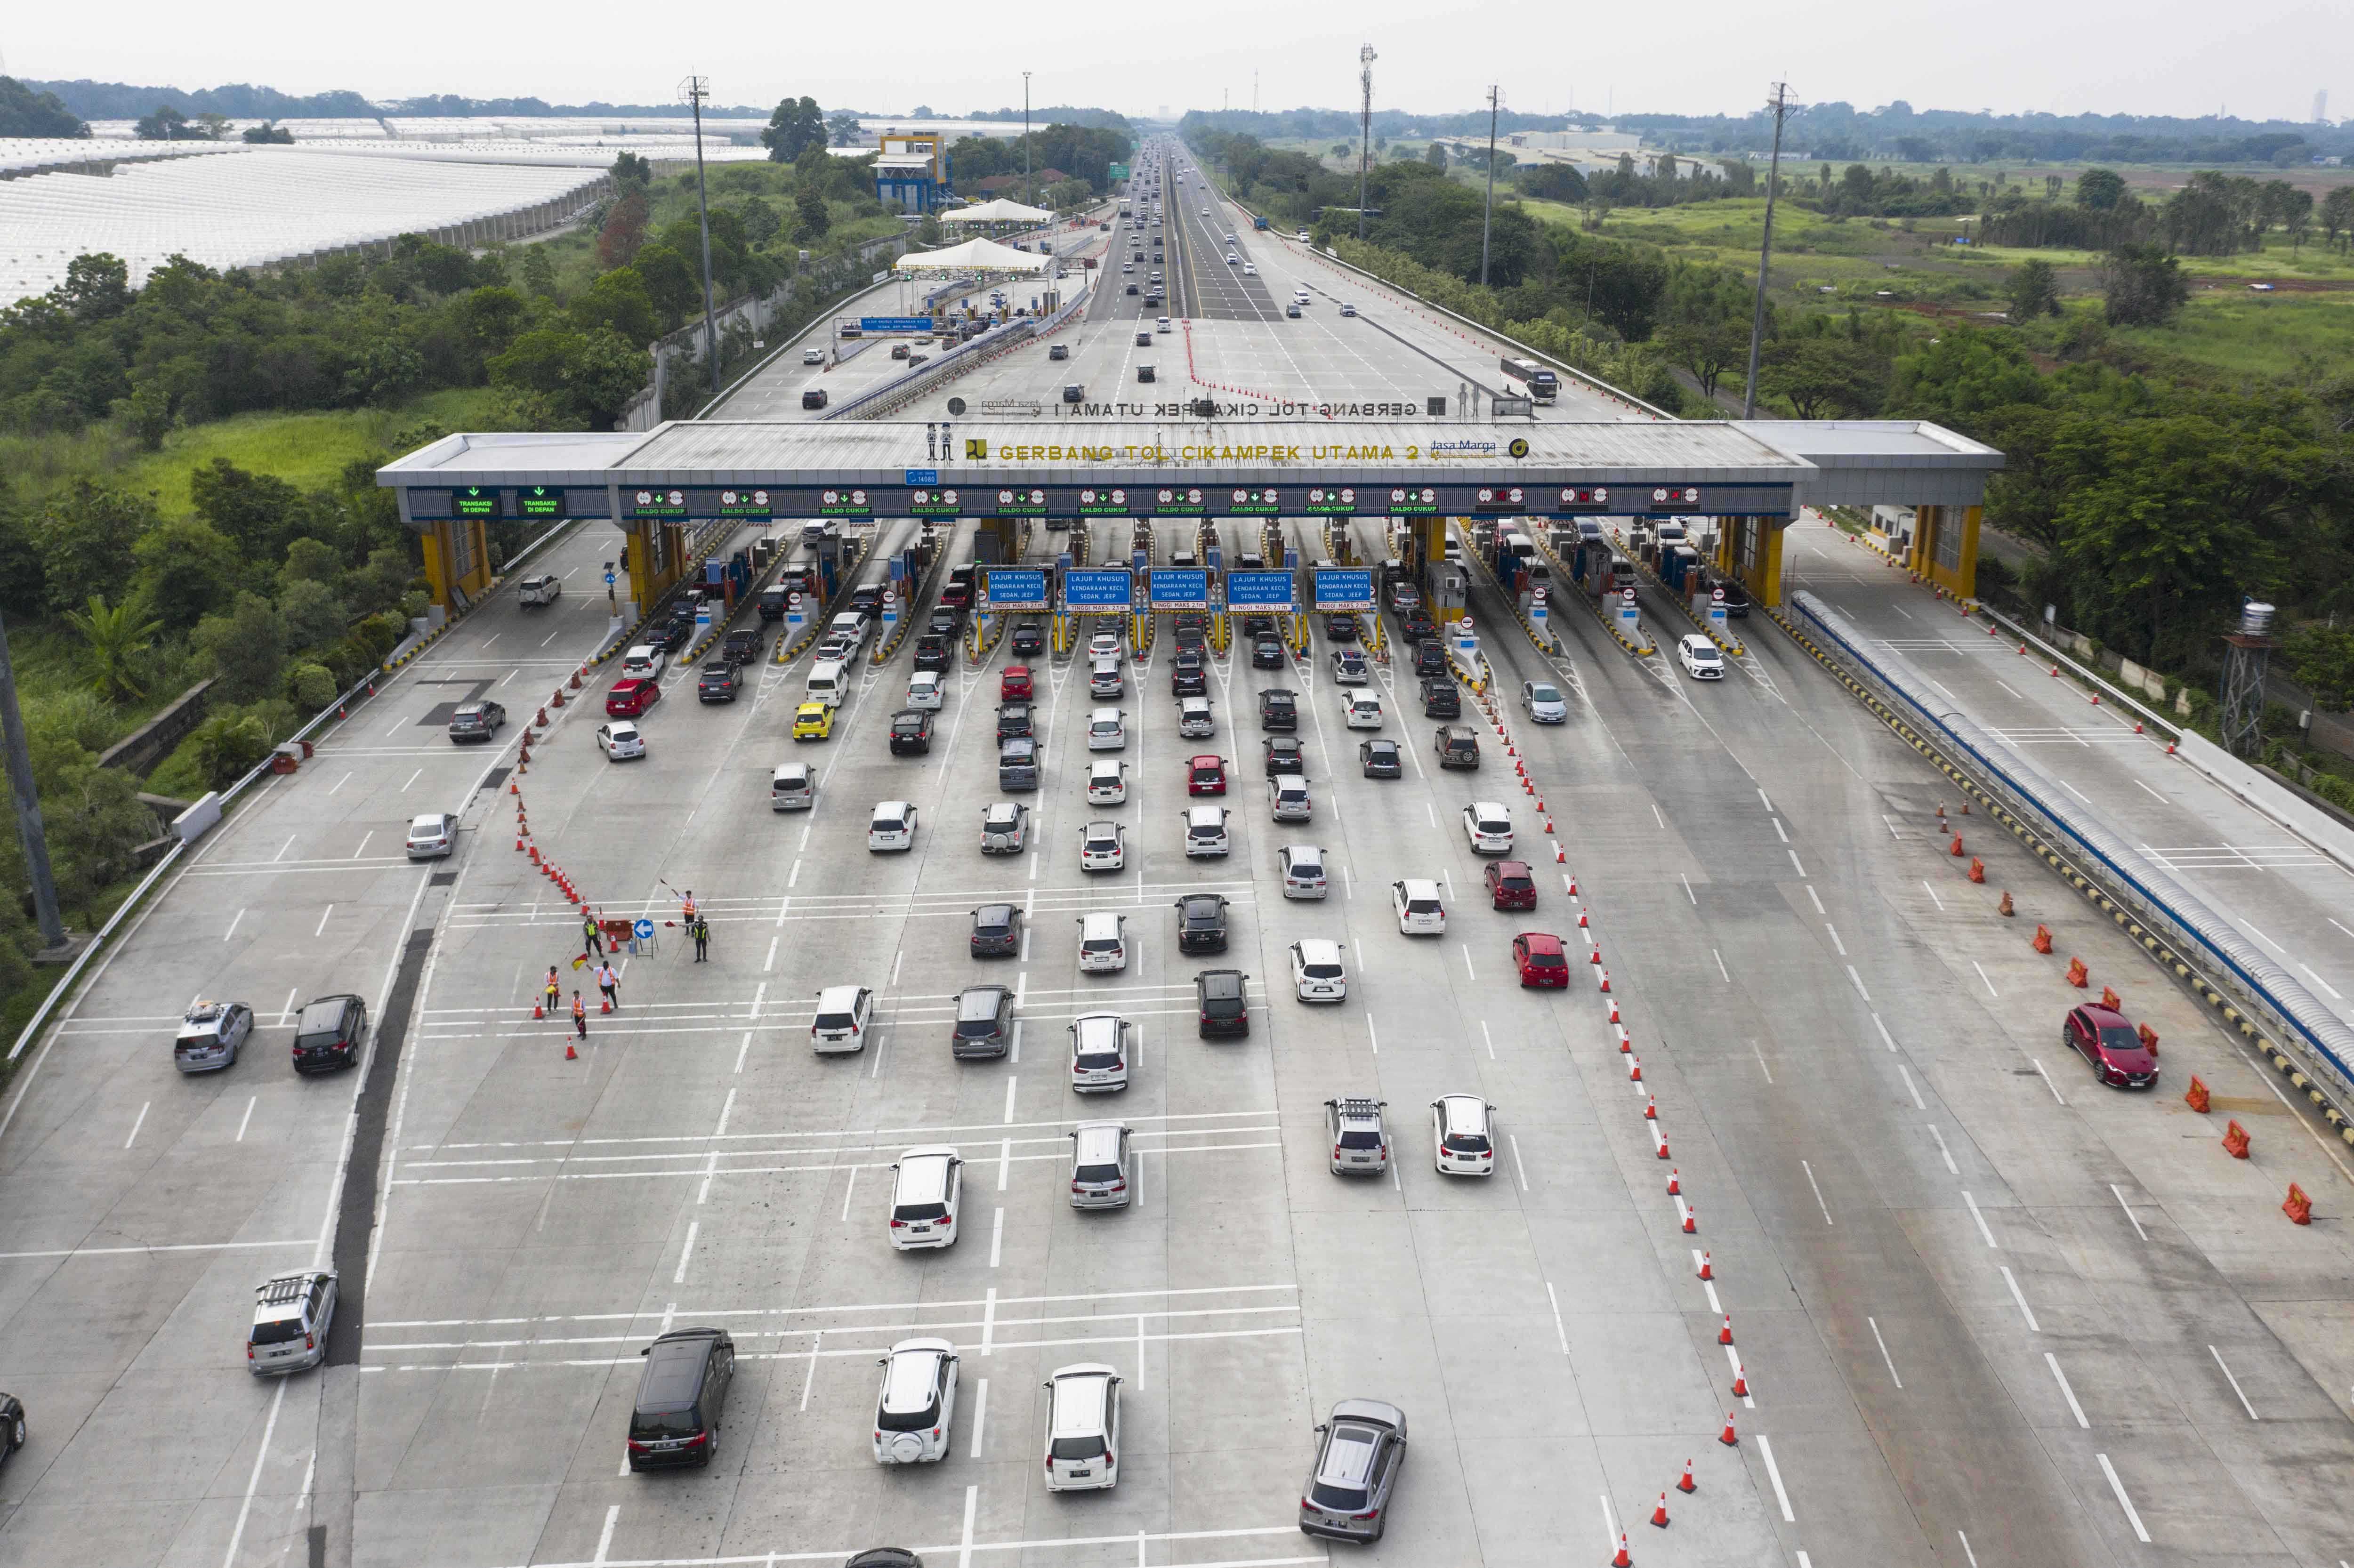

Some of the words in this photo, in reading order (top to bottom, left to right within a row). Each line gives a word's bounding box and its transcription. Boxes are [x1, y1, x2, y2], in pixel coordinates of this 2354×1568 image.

[1000, 445, 1113, 460] GERBANG
[1125, 445, 1170, 460] TOL
[1182, 445, 1300, 460] CIKAMPEK
[1313, 445, 1394, 460] UTAMA
[1406, 445, 1419, 460] 2
[1432, 440, 1455, 450] Jasa
[1460, 440, 1496, 452] Marga
